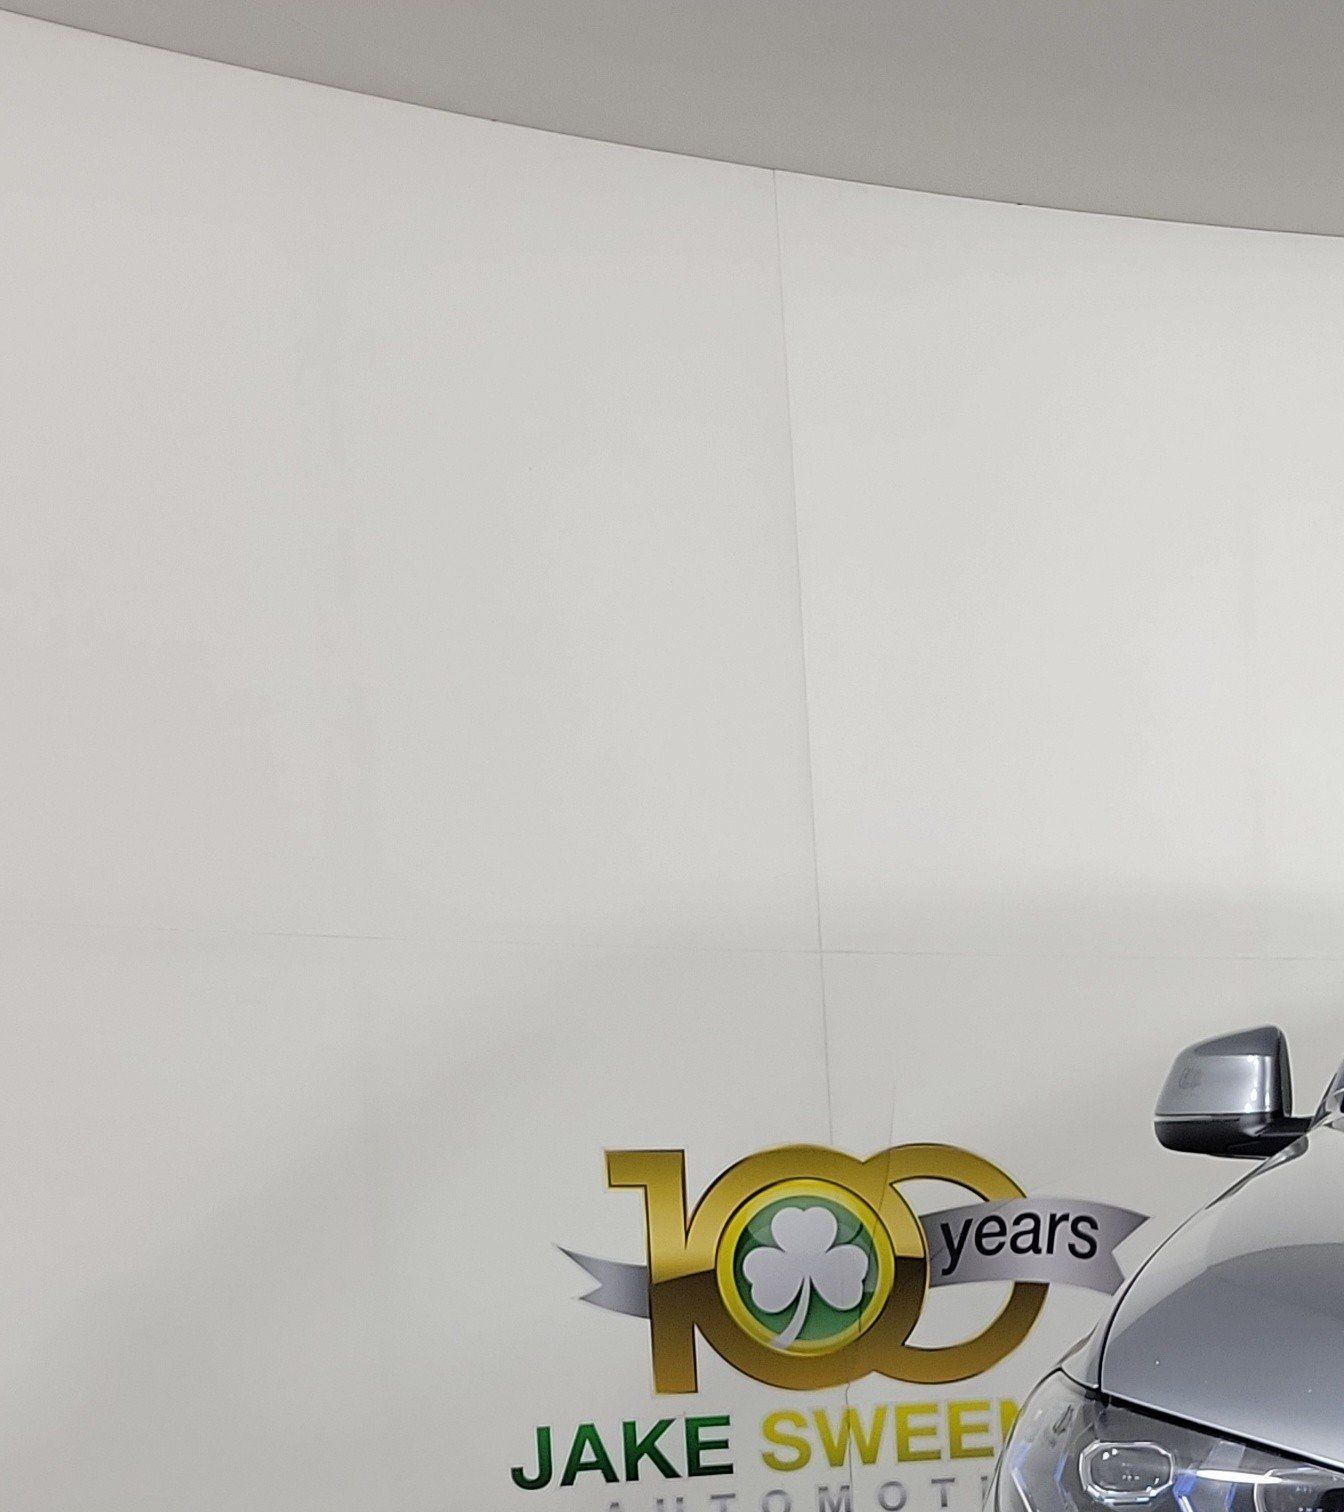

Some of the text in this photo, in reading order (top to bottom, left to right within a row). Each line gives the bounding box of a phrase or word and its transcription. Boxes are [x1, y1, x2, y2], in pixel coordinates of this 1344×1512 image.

[604, 1142, 1099, 1395] 100 years
[511, 1414, 734, 1491] JAKE
